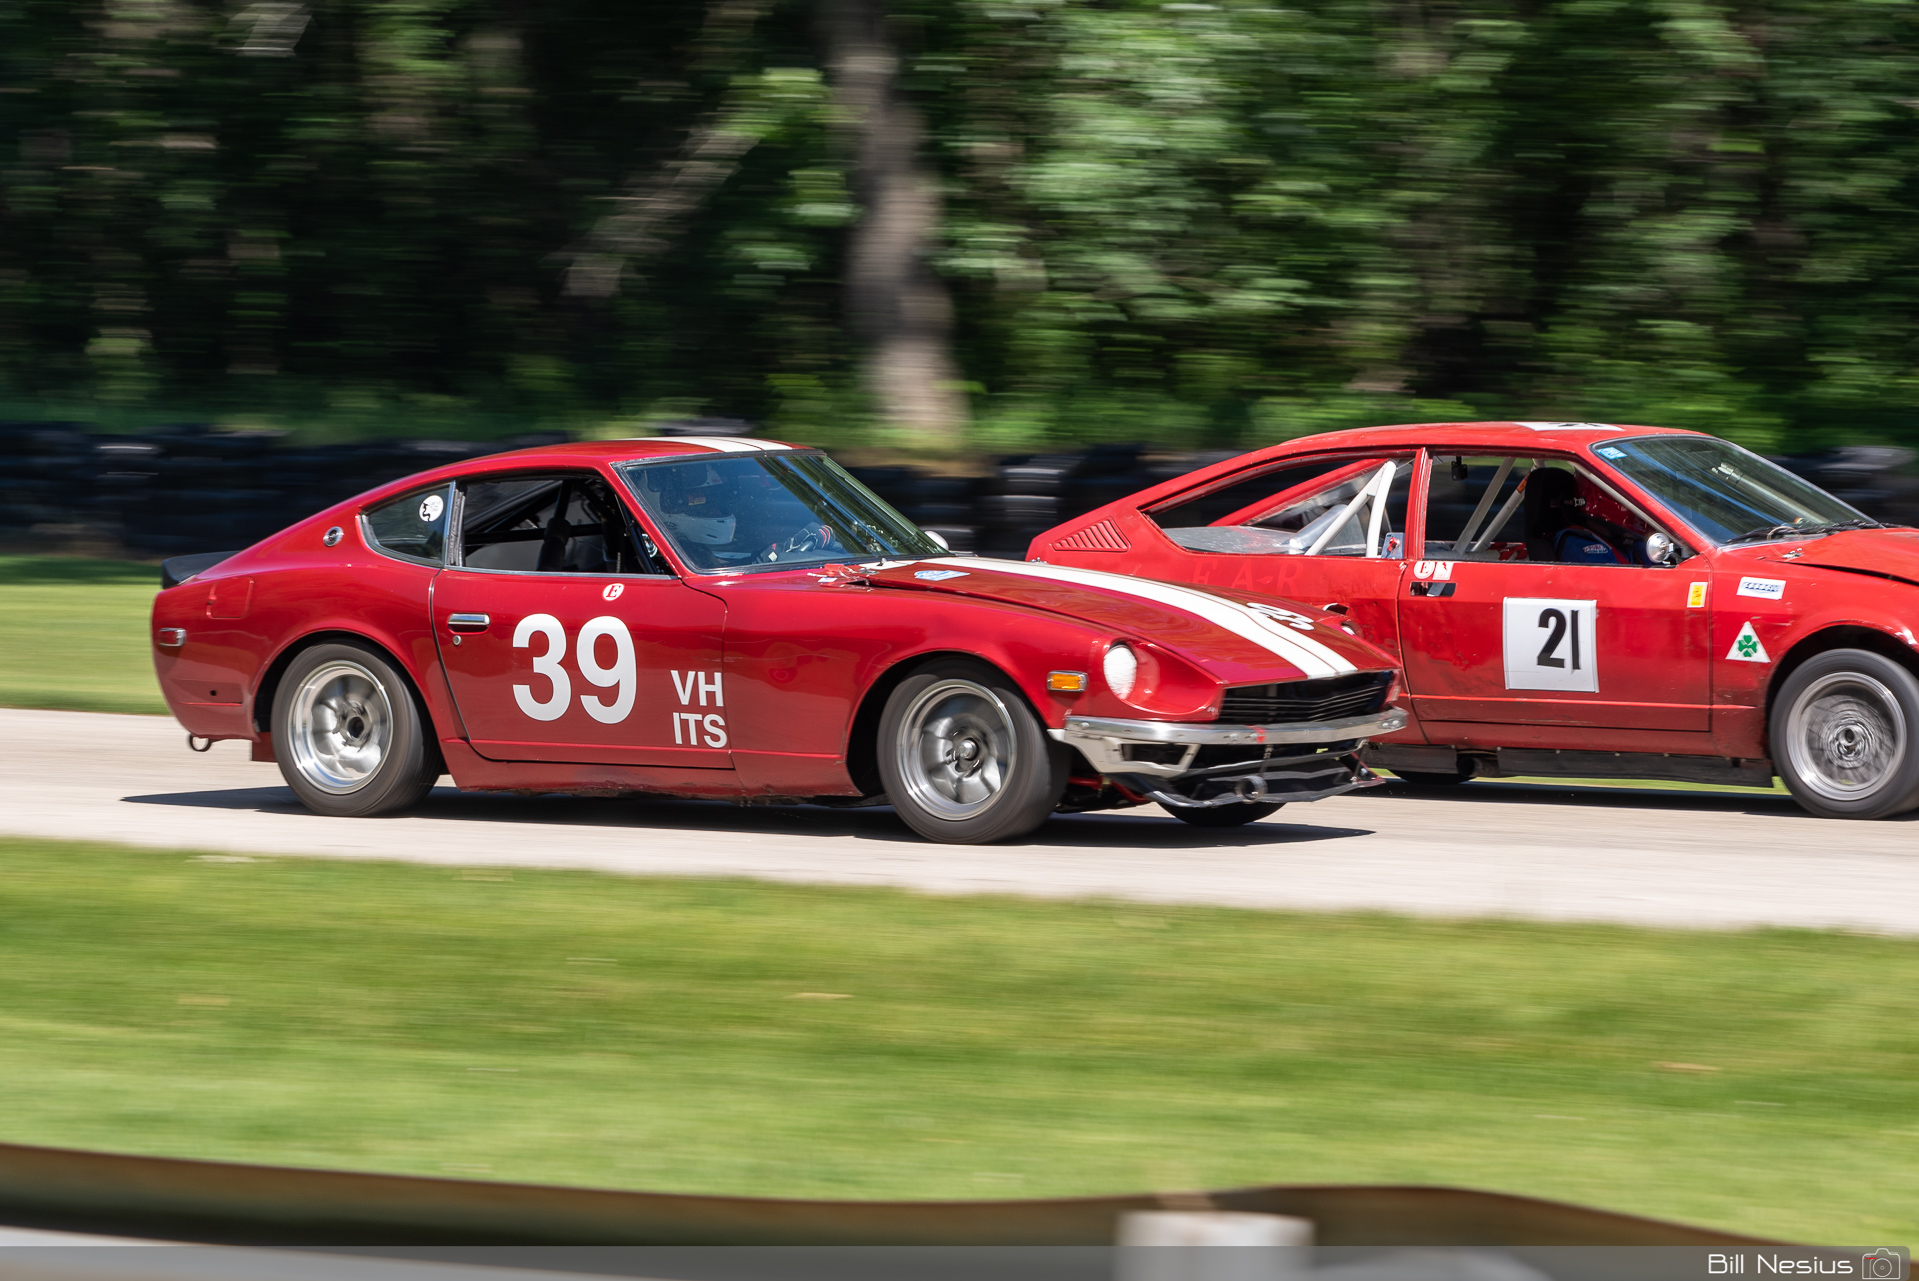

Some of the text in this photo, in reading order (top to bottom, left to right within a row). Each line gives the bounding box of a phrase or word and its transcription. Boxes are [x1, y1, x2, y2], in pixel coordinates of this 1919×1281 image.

[606, 584, 621, 599] E
[1536, 607, 1581, 670] 21
[512, 613, 637, 724] 39
[670, 669, 724, 707] VH
[672, 711, 728, 749] ITS
